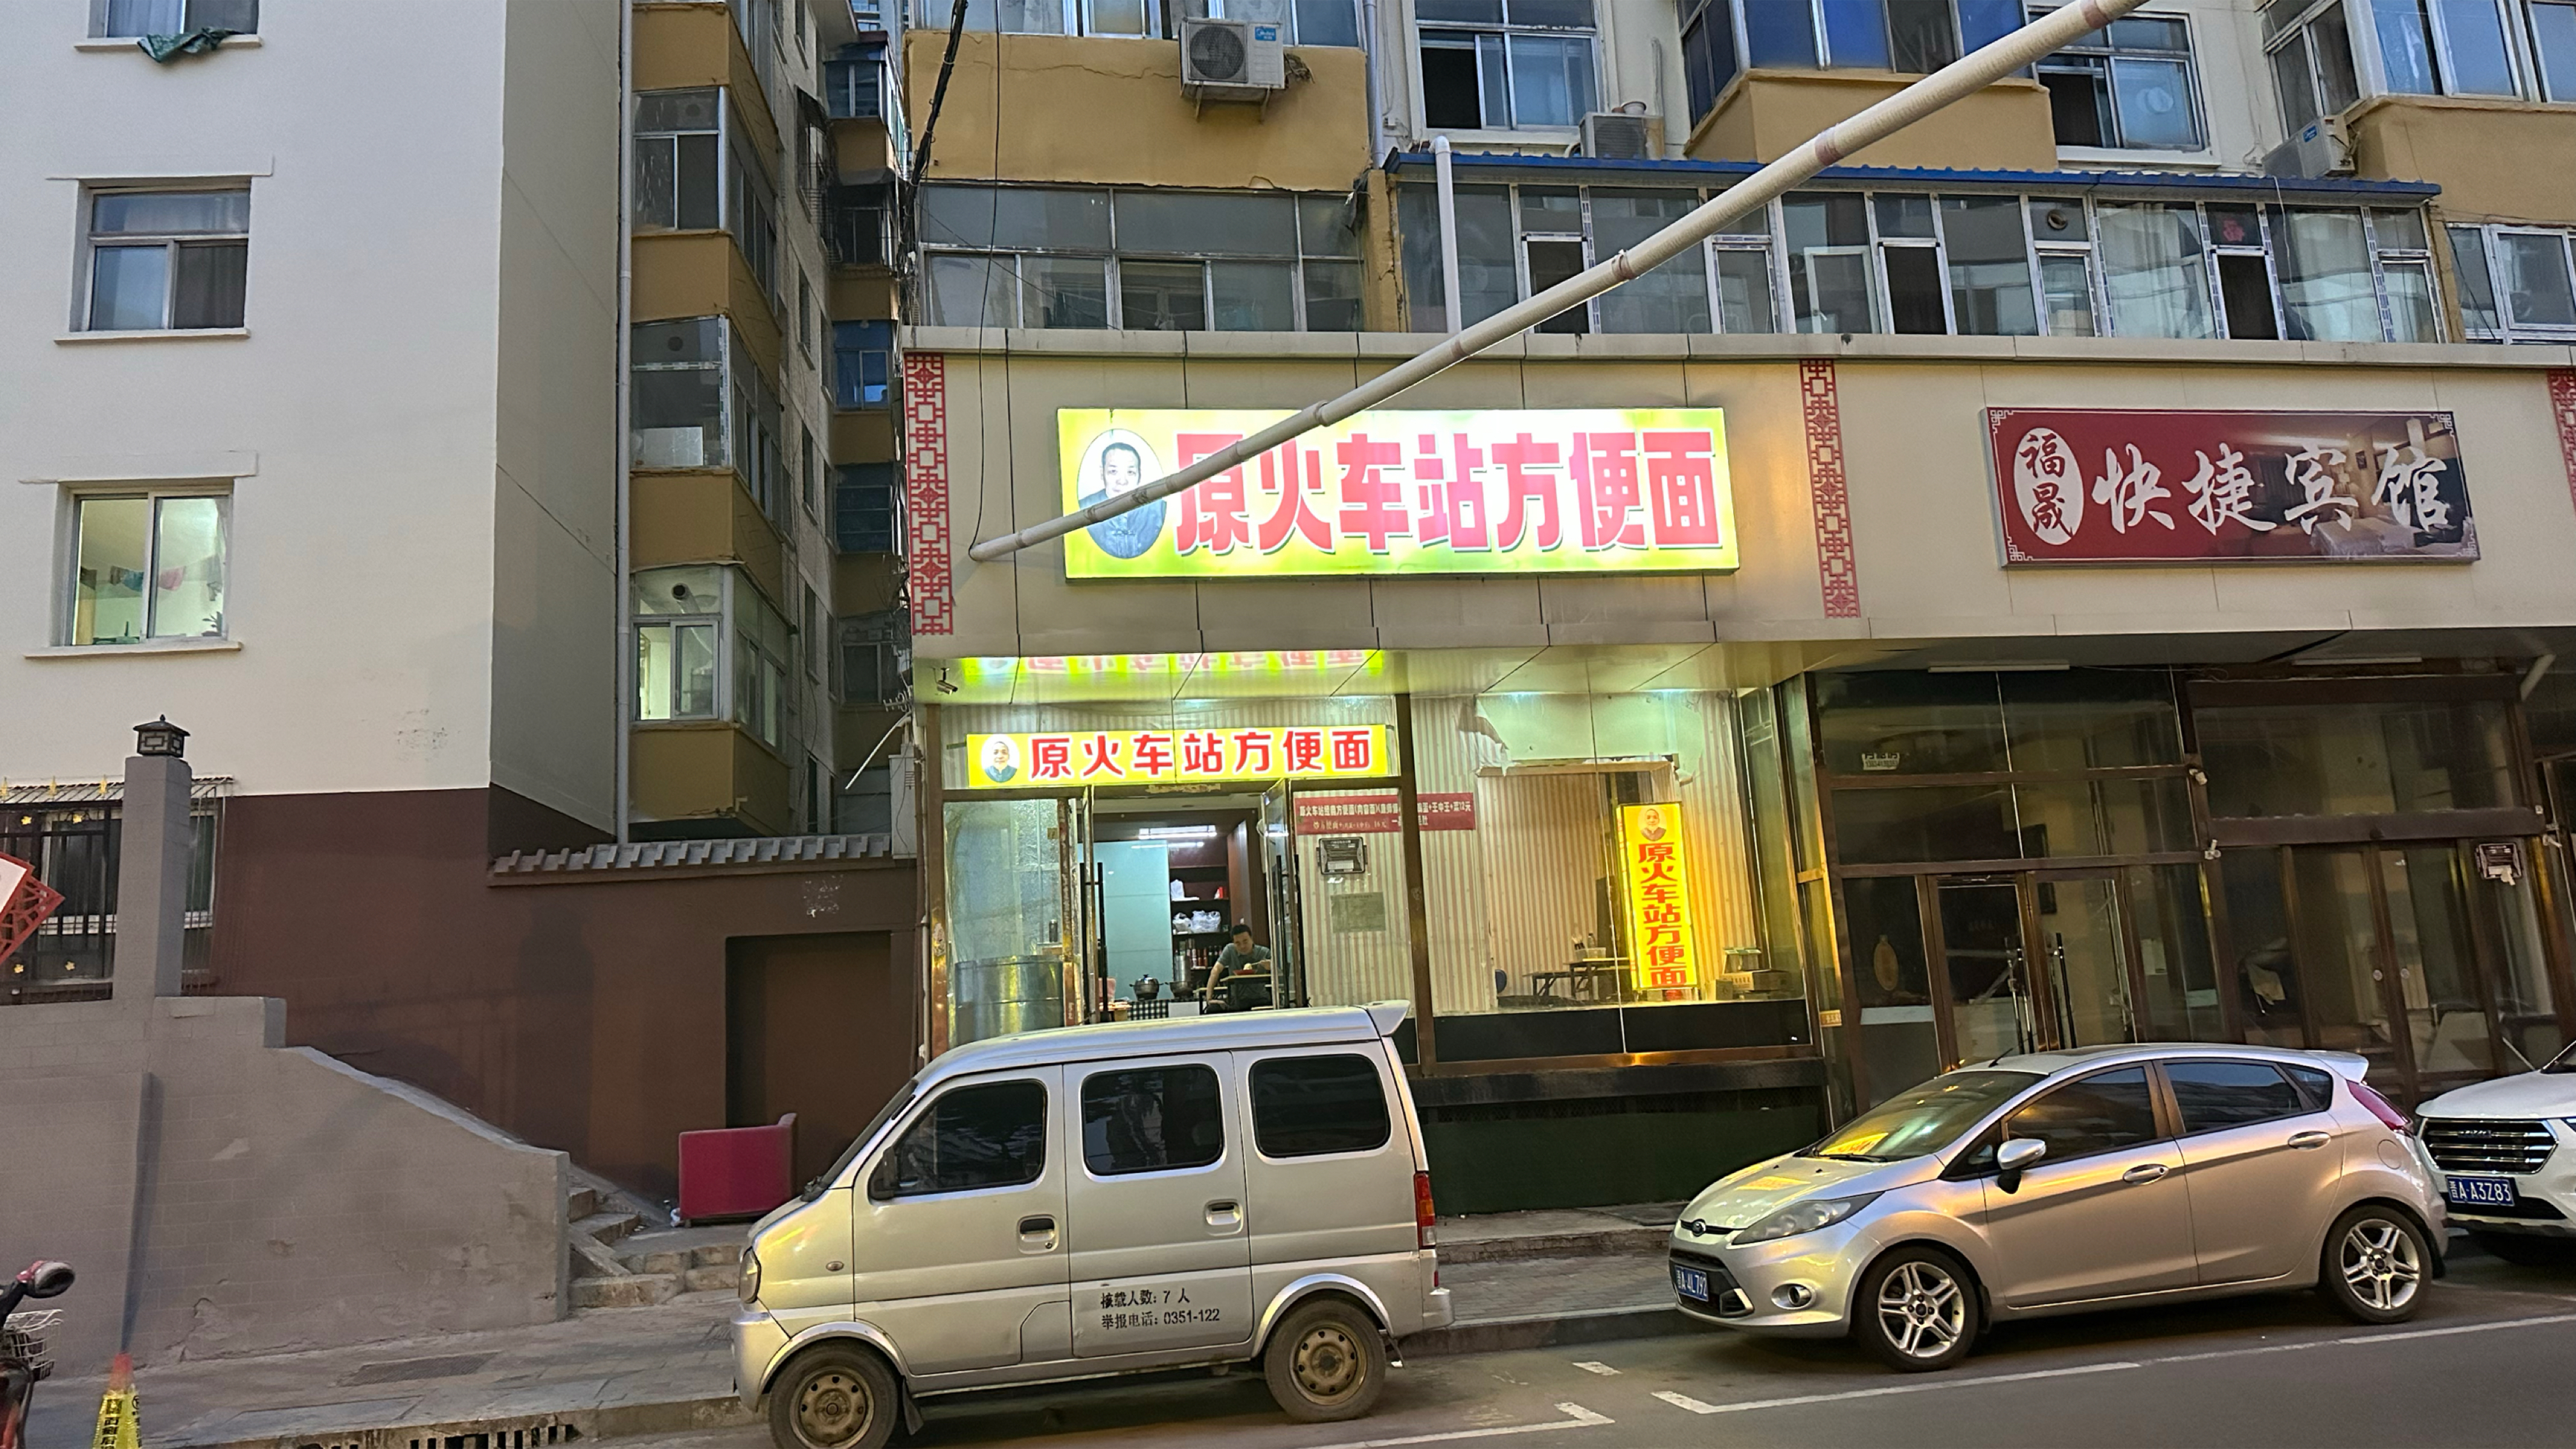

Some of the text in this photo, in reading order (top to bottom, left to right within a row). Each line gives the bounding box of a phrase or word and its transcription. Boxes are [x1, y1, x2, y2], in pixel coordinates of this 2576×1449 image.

[1176, 430, 1721, 553] 原火车站方便面
[2021, 435, 2071, 537] 福晟
[2092, 443, 2451, 535] 快捷宾馆
[1031, 730, 1371, 778] 原火车站方便面
[1638, 842, 1687, 986] 原火车站方便面
[1163, 1291, 1170, 1303] 7
[1178, 1288, 1190, 1303] 人
[1164, 1308, 1220, 1324] 0351-122
